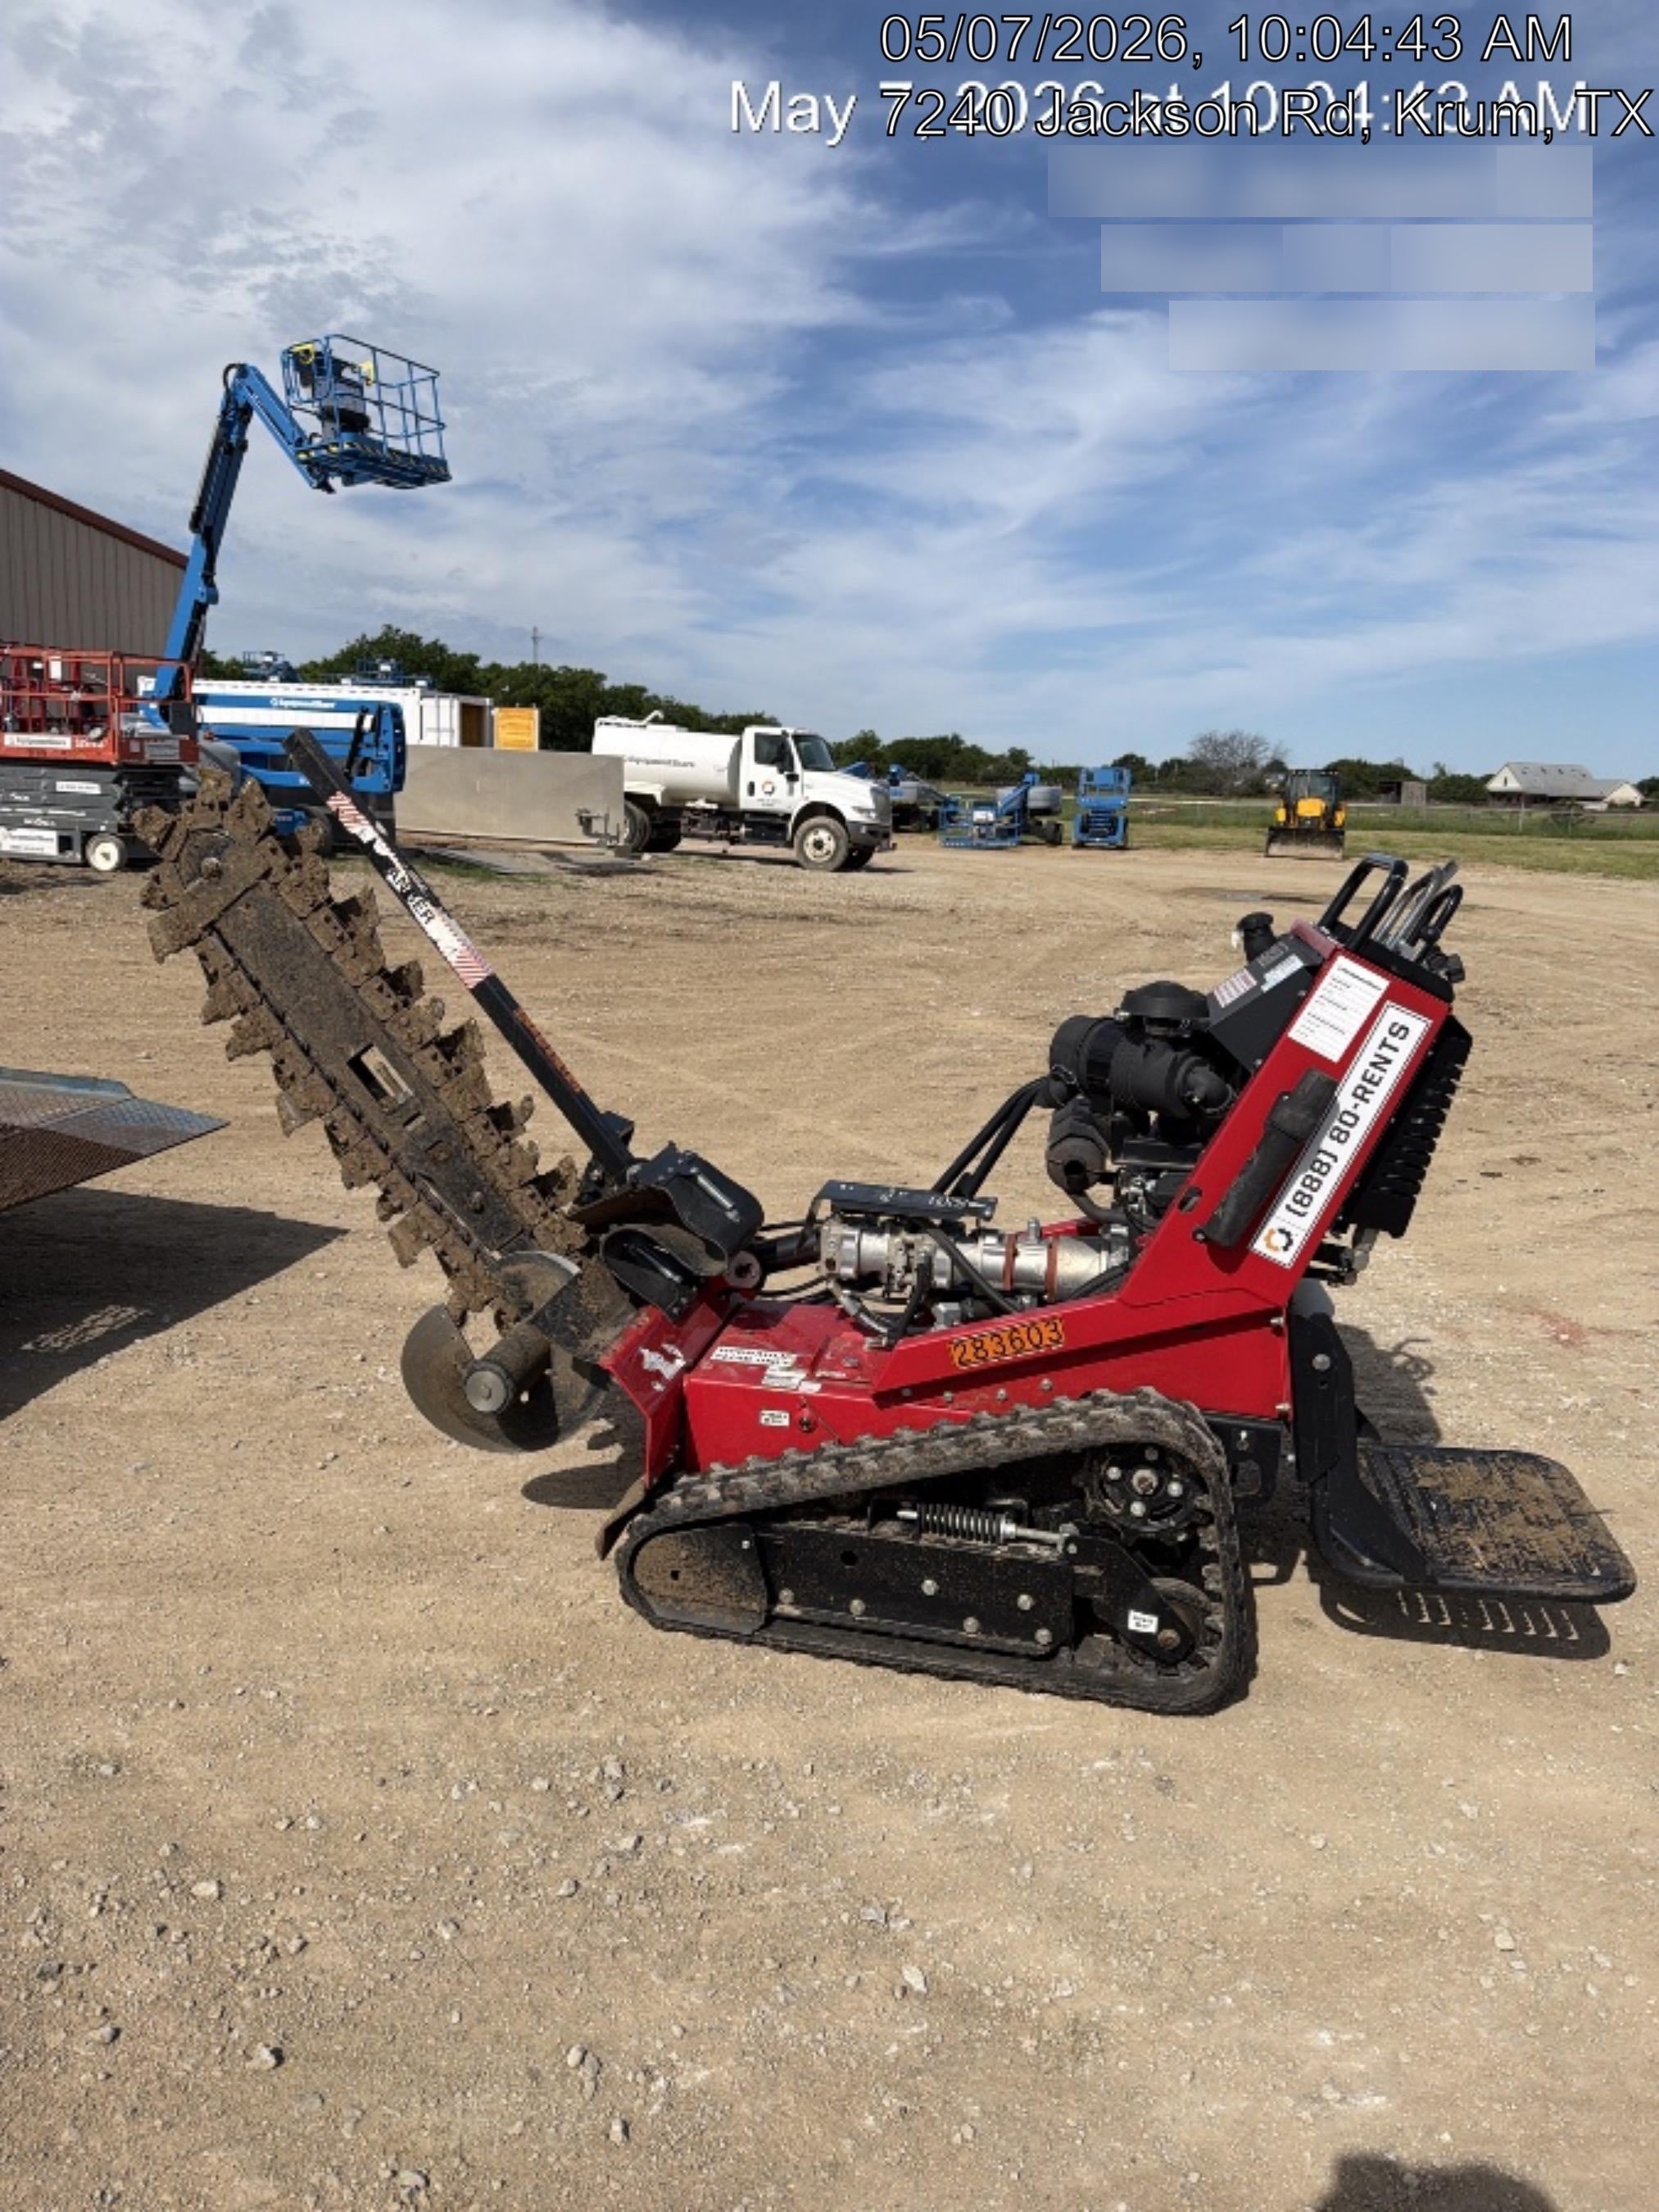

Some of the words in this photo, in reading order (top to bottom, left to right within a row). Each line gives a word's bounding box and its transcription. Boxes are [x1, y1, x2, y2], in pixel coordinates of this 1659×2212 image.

[1285, 1149, 1339, 1218] (888)
[1329, 1021, 1411, 1145] 80-RENTS
[954, 1316, 1063, 1366] 283603
